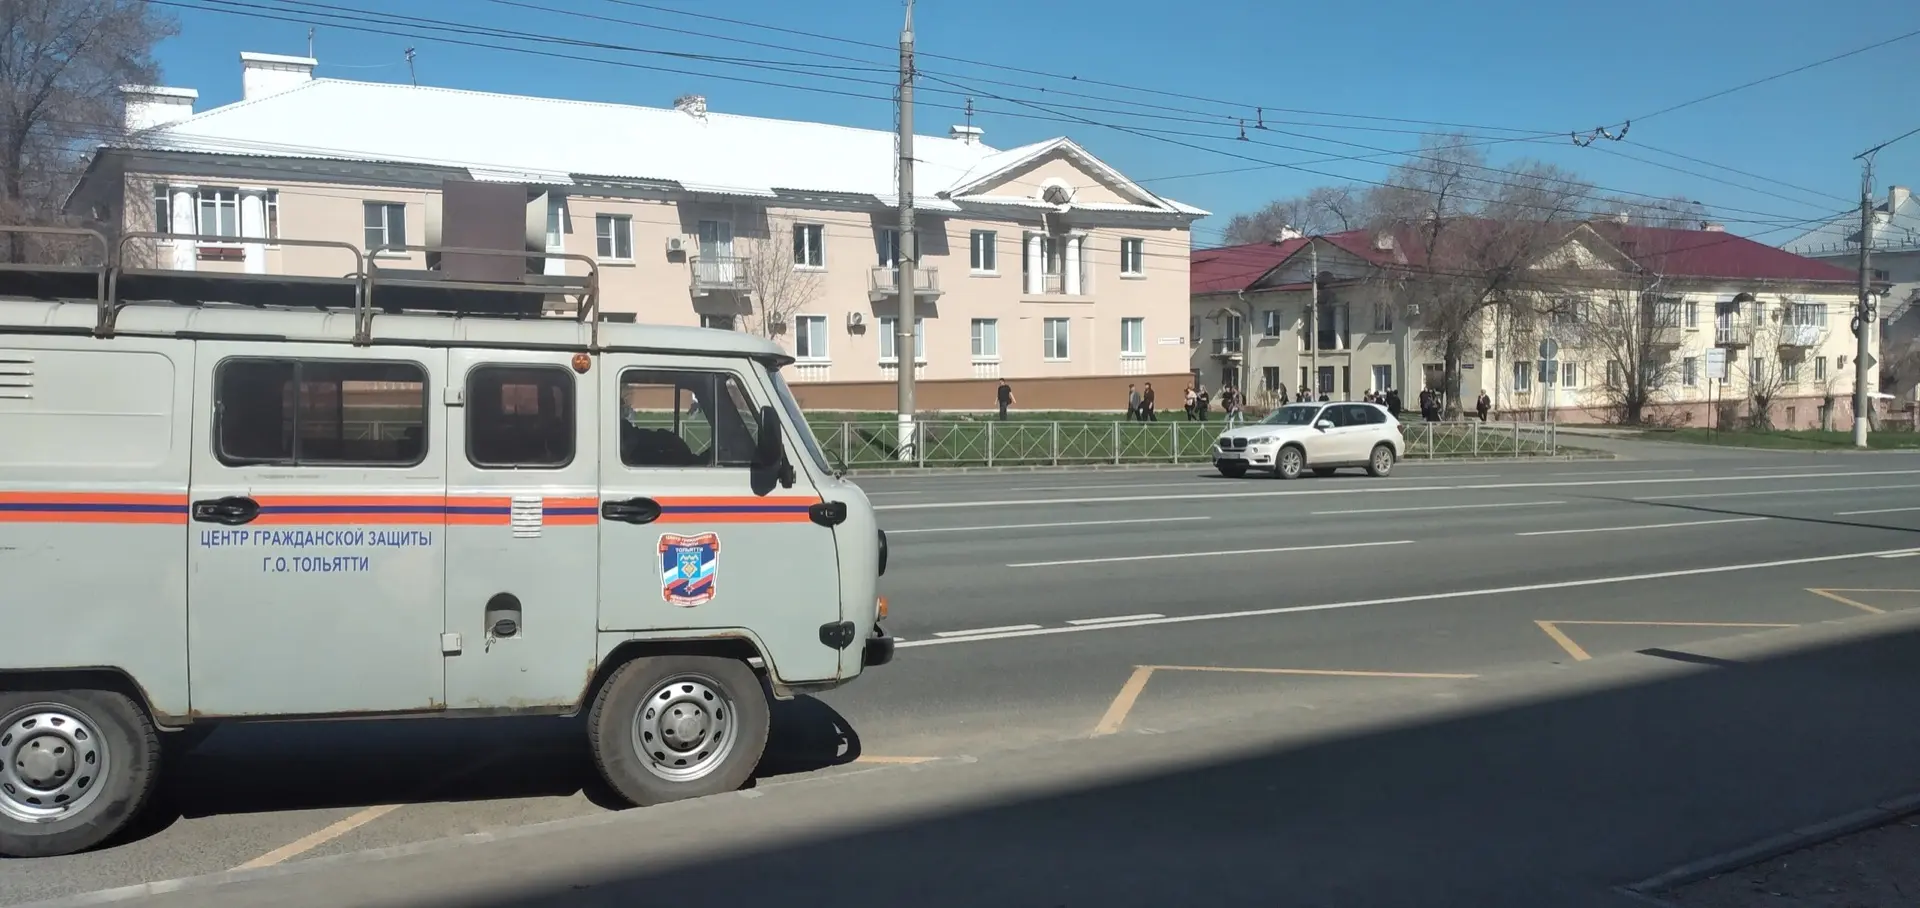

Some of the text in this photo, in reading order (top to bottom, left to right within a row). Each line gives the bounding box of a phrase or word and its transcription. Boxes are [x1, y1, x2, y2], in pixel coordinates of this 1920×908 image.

[201, 528, 432, 548] ЦЕНТР ГРАЖДАНСКОЙ ЗАЩИТЫ
[263, 556, 369, 572] Г.О. ТОЛЬЯТТИ
